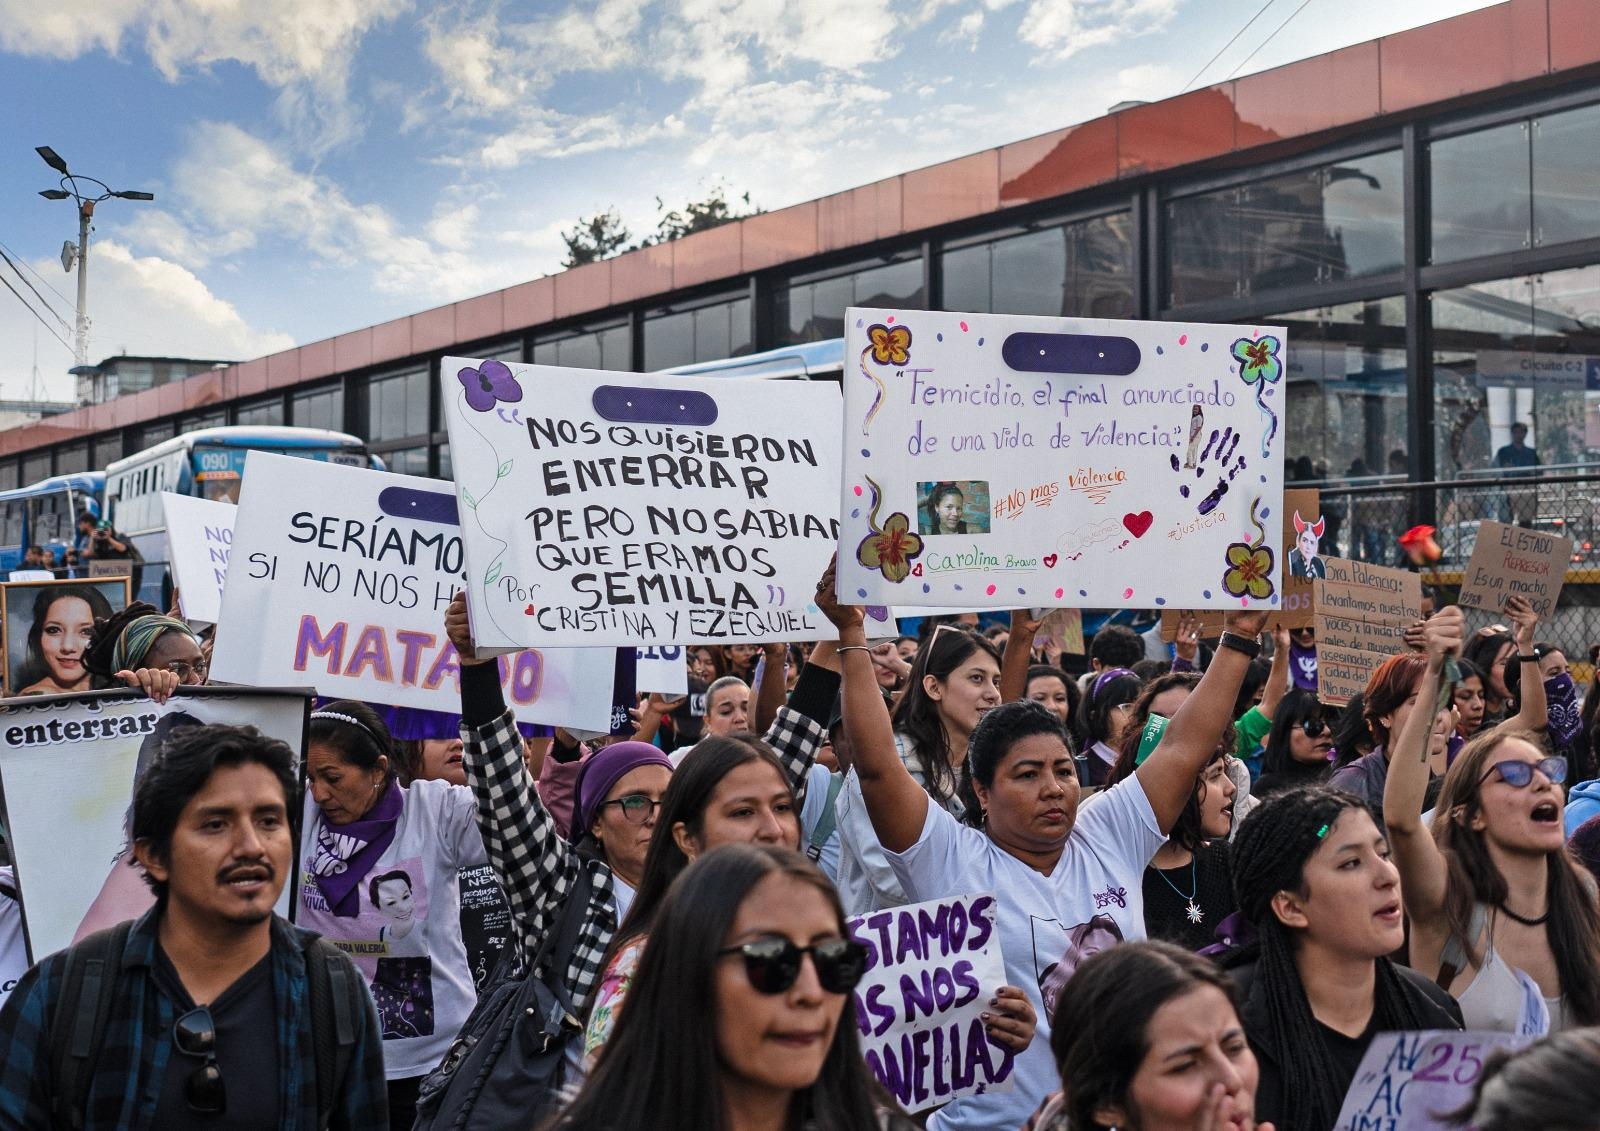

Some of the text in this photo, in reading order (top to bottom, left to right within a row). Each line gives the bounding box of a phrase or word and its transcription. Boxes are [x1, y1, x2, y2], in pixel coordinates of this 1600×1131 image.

[1033, 380, 1052, 405] el
[1058, 383, 1108, 417] final
[1122, 379, 1235, 407] anunciado
[907, 420, 937, 456] de
[951, 433, 986, 452] una
[1049, 421, 1071, 449] de
[203, 452, 228, 470] 090
[542, 453, 769, 500] ENTERRAR
[1030, 480, 1060, 500] mas
[525, 504, 635, 542] PERO
[287, 511, 468, 583] SERÍAMO
[926, 545, 1038, 570] Carolina Bravo
[1500, 527, 1554, 555] EL ESTADO
[622, 541, 777, 579] ERAMOS
[1502, 550, 1551, 576] REPRESOR
[247, 552, 278, 581] SI
[303, 560, 341, 594] NO
[353, 569, 419, 609] NOS
[499, 575, 541, 603] Por
[1509, 578, 1547, 596] macho
[1321, 583, 1377, 614] Levantamos
[1378, 599, 1420, 619] nuestras
[670, 610, 679, 640] Y
[689, 608, 816, 638] EZEQUIEL
[1373, 619, 1393, 638] vida
[5, 712, 158, 746] enterrar
[456, 865, 494, 880] SOMETH
[354, 942, 386, 954] VALERIA
[847, 895, 993, 975] STAMOS
[899, 959, 980, 1023] NOS
